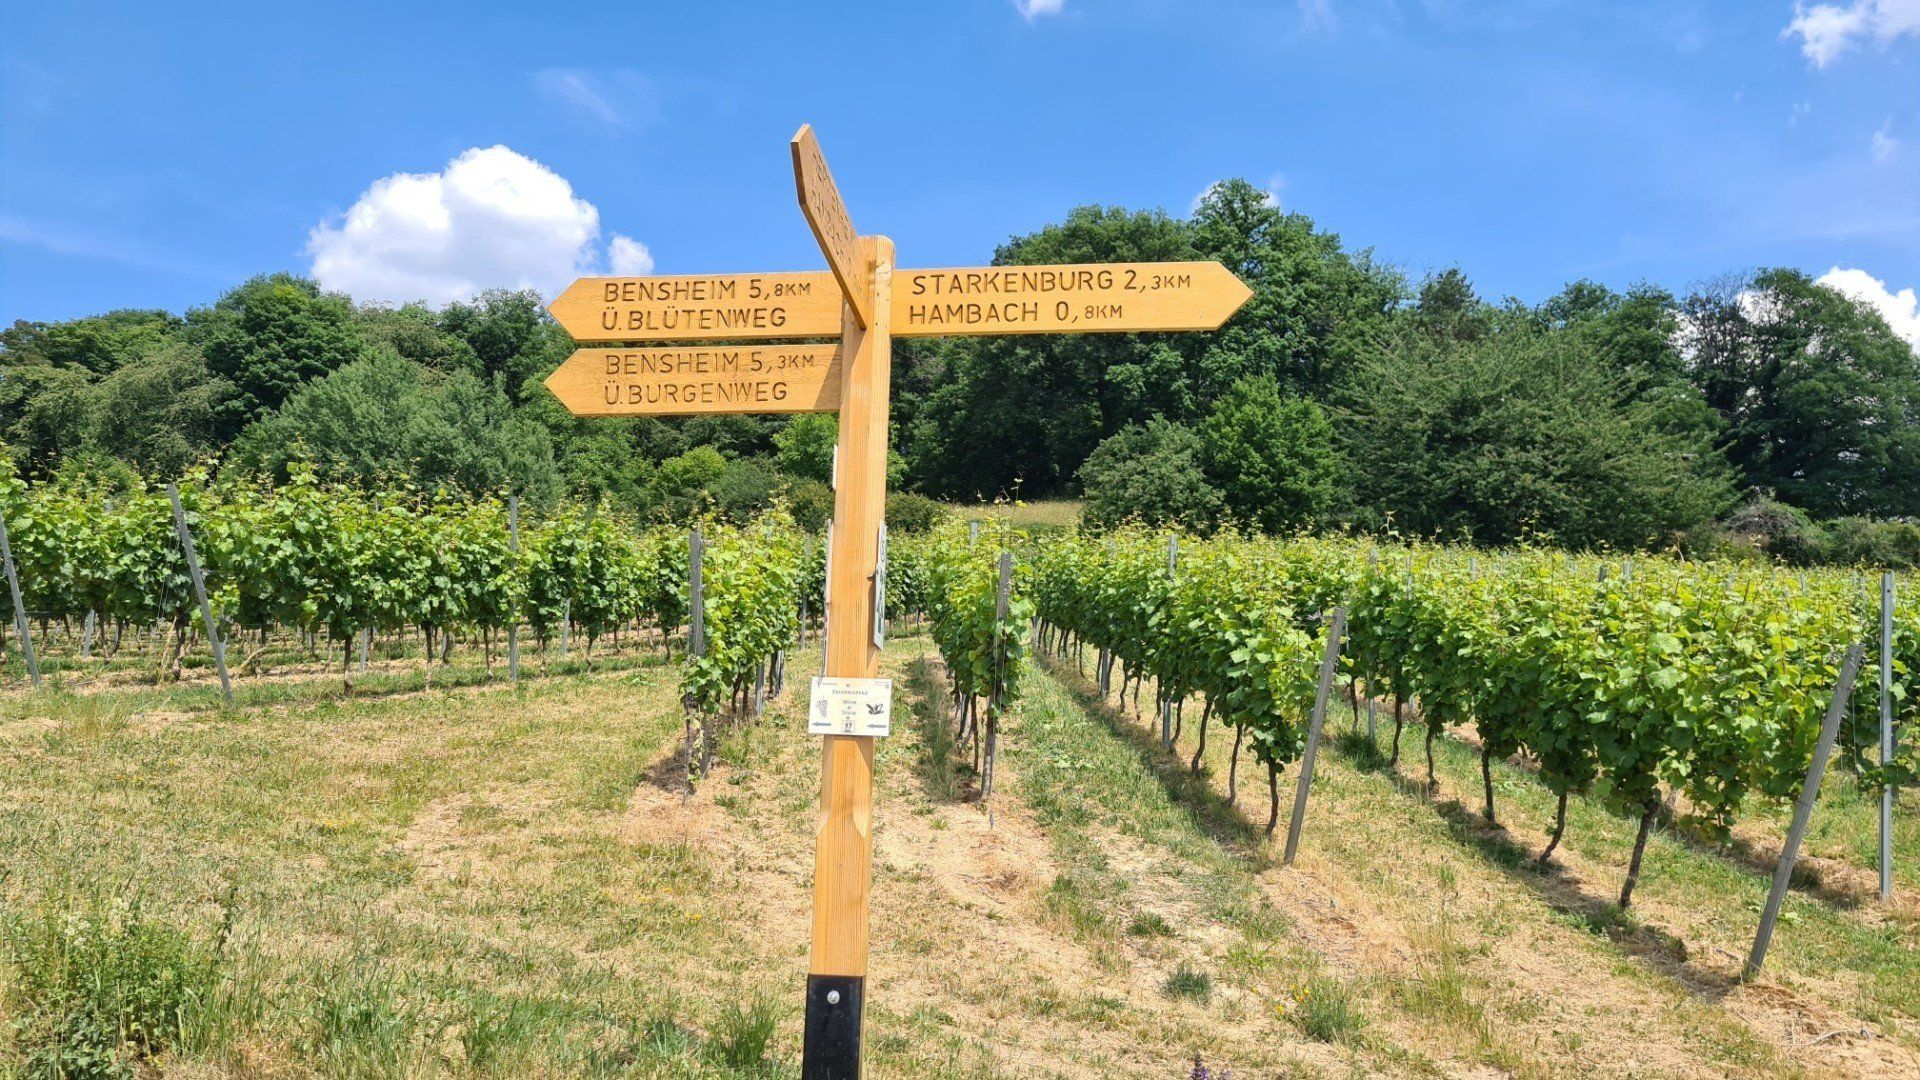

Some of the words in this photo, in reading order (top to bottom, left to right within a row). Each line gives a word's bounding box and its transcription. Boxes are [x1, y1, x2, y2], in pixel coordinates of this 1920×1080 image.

[604, 280, 736, 302] BENSHEIM
[749, 278, 811, 301] 5,8KM
[912, 270, 1113, 295] STARKENBURG
[1124, 269, 1191, 293] 2,3KM
[601, 306, 787, 331] Ü.BLÜTENWEG
[909, 302, 1038, 325] HAMBACH
[605, 352, 739, 375] BENSHEIM
[750, 351, 815, 374] 5,3KM
[604, 381, 788, 405] Ü.BURGENWEG
